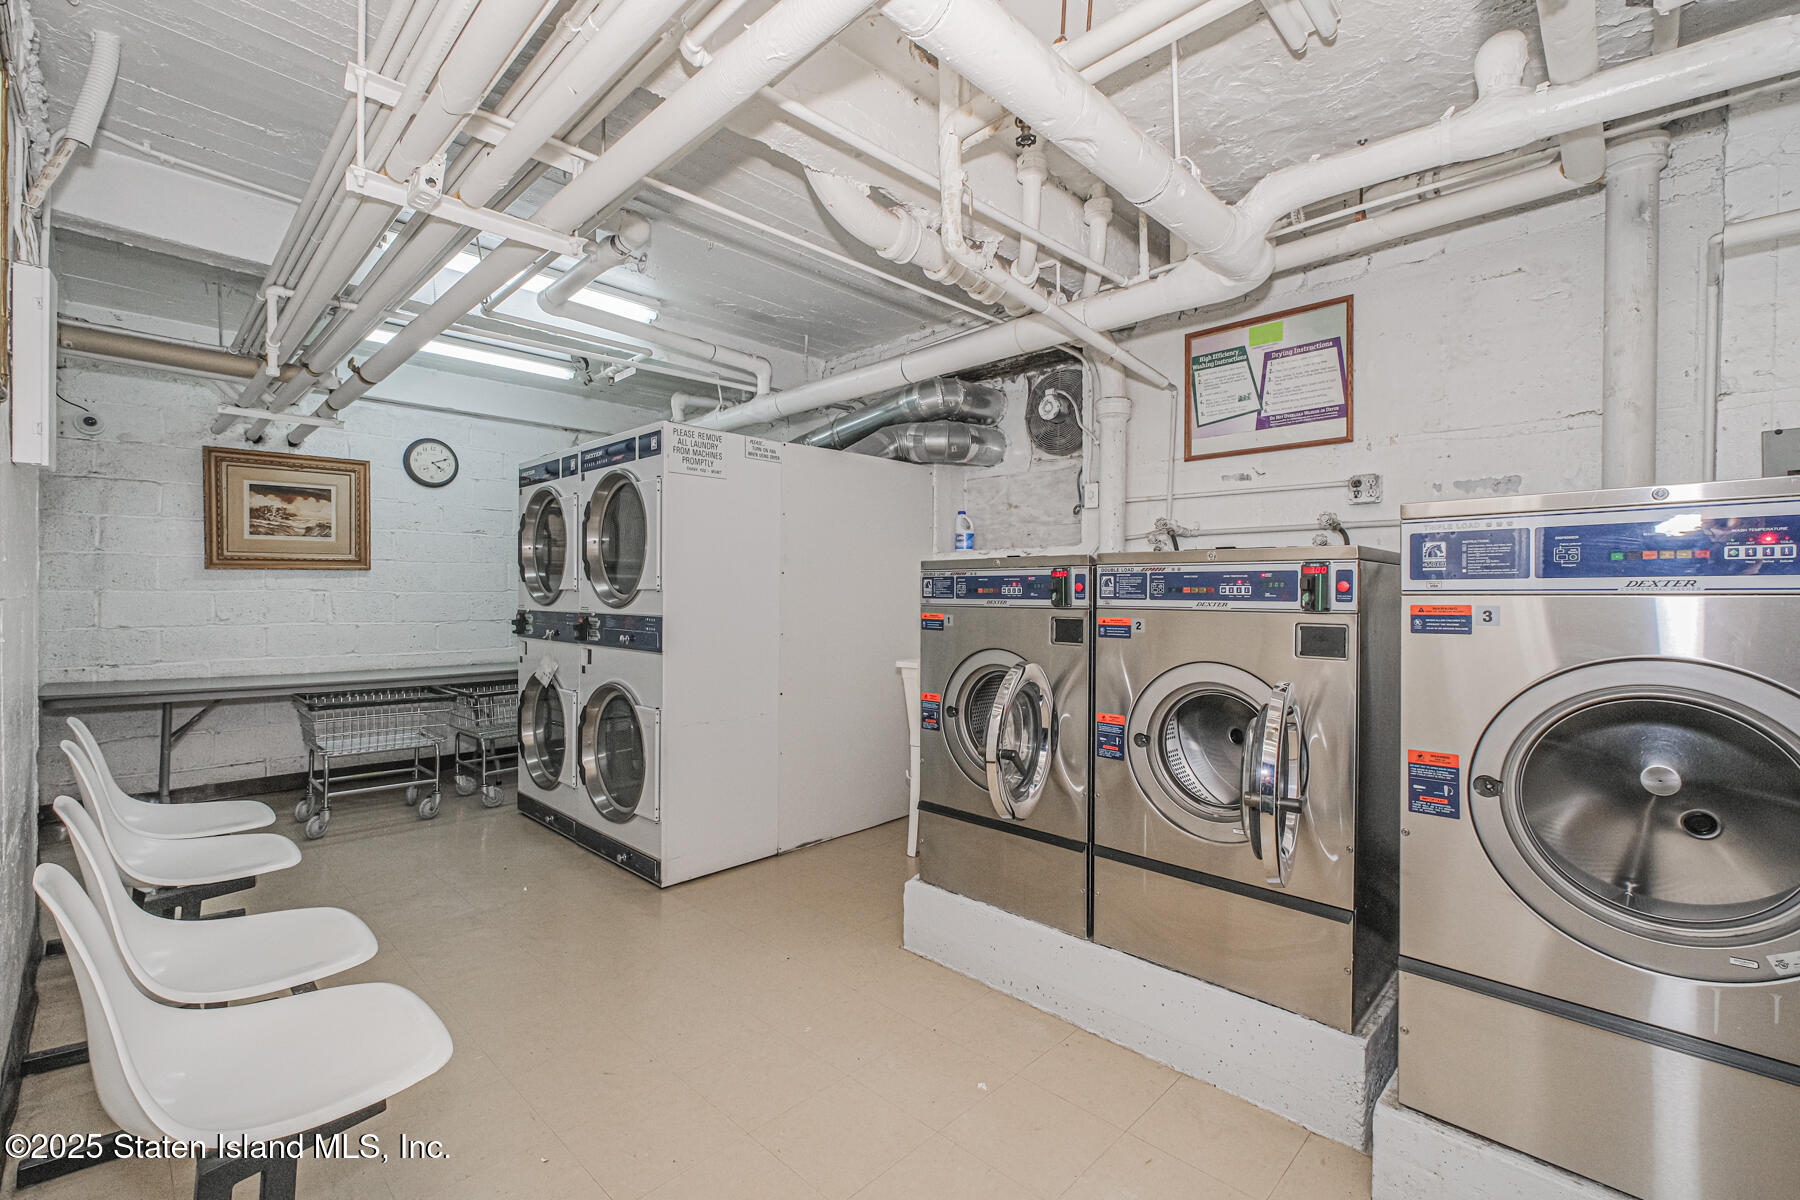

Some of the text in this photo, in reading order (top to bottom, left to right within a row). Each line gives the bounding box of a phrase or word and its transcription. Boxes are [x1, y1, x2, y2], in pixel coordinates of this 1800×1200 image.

[1271, 349, 1293, 359] Drying
[1294, 341, 1333, 354] Instructions
[1214, 355, 1247, 366] Instructions
[673, 428, 722, 443] PLEASE REMOVE
[678, 438, 719, 450] ALL LAUNDRY
[673, 446, 723, 460] FROM MACHINES
[682, 456, 714, 467] PROMPTLY
[1625, 580, 1697, 588] DEXTER
[1482, 610, 1493, 623] 3
[1135, 621, 1142, 631] 2
